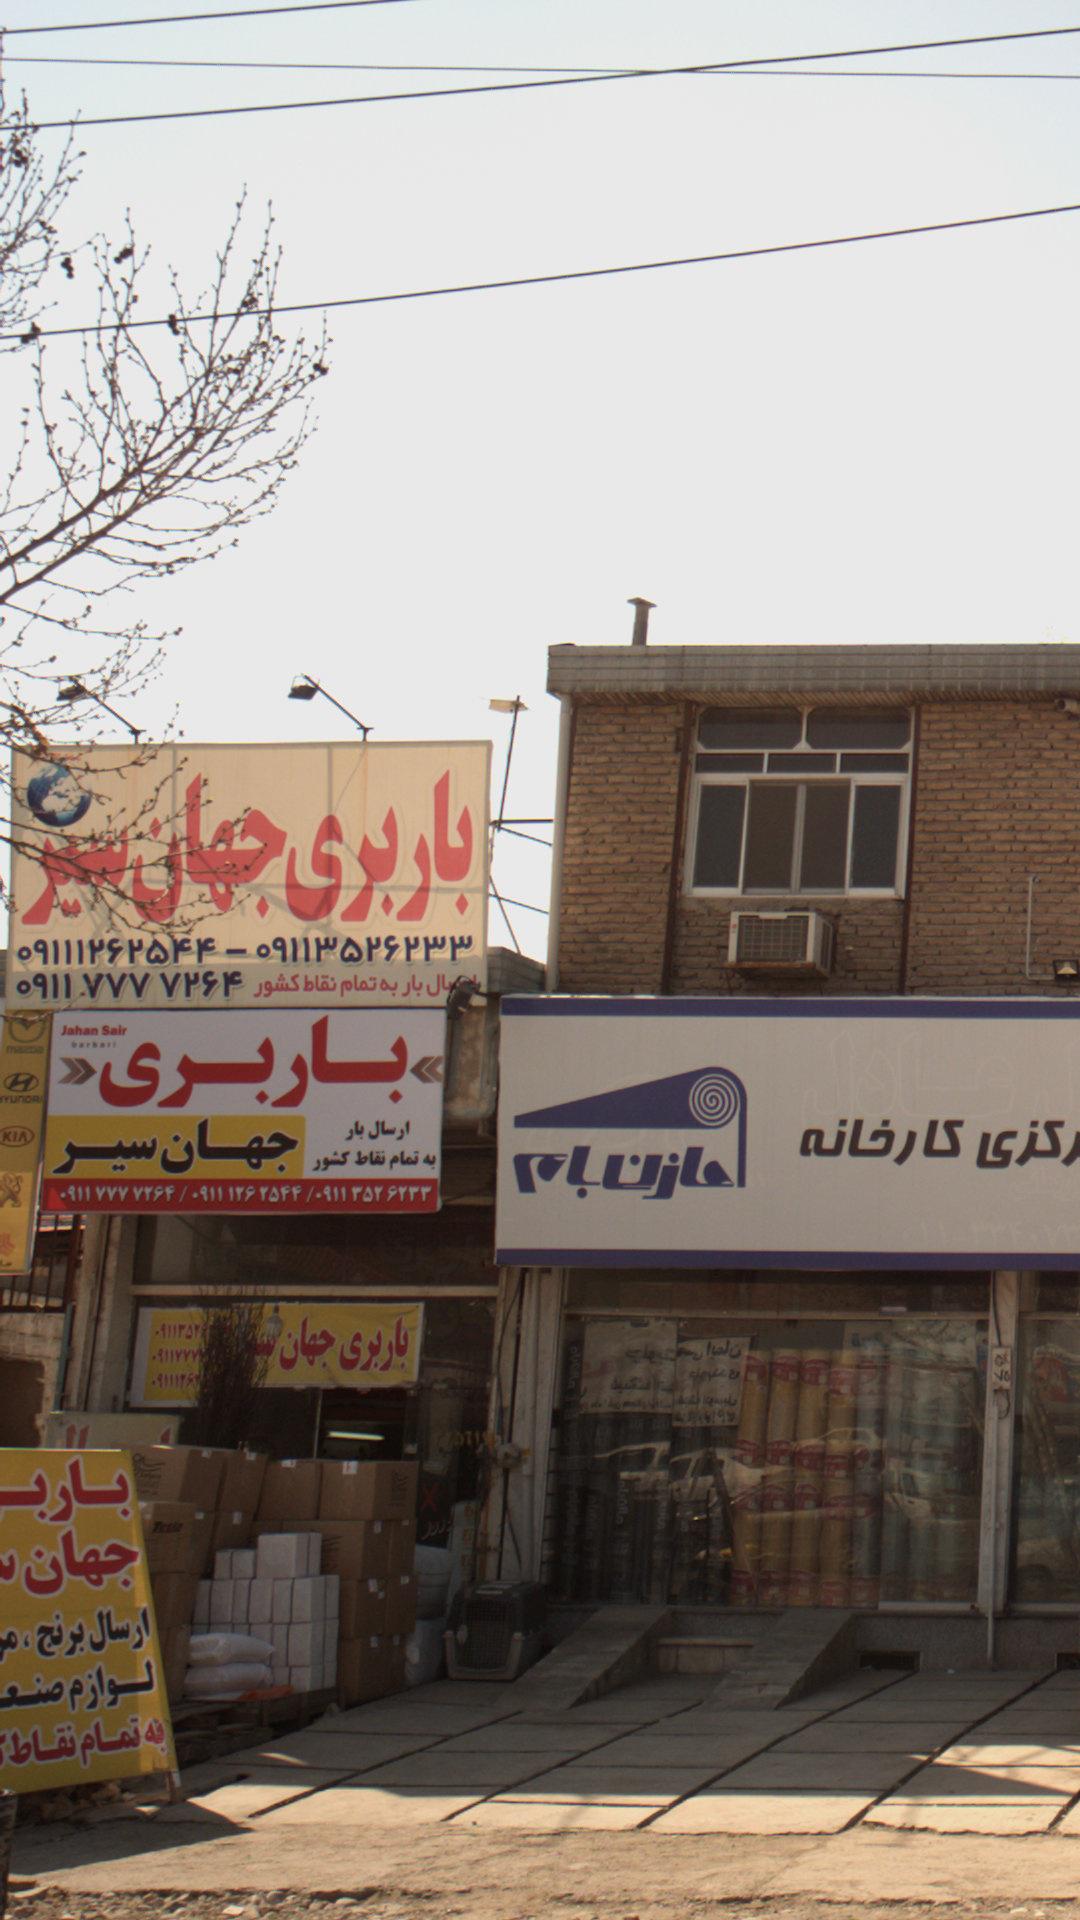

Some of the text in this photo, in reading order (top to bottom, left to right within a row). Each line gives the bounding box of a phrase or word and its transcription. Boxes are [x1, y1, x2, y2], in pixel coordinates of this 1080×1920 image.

[21, 769, 474, 925] باربری جهان سیر
[253, 973, 300, 998] کشور
[303, 974, 337, 992] نقاط
[340, 974, 377, 997] تمام
[379, 979, 399, 996] به
[402, 974, 423, 996] بار
[61, 1024, 128, 1036] Jahan Sair
[99, 1014, 409, 1109] باربری
[2, 1129, 28, 1142] KIA
[52, 1118, 300, 1175] جهان سیر
[345, 1120, 410, 1140] ارسال بار
[799, 1118, 1080, 1169] کارخانه رکزی
[312, 1151, 436, 1171] به تمام نقاط کشور
[278, 1315, 336, 1371] جهان
[338, 1315, 409, 1372] باربری
[0, 1458, 130, 1522] بارب
[25, 1530, 140, 1595] جهان
[36, 1614, 85, 1656] برنج
[89, 1607, 151, 1652] ارسال
[70, 1660, 155, 1711] لوازم
[10, 1724, 75, 1764] نقاط
[80, 1717, 141, 1766] تمام
